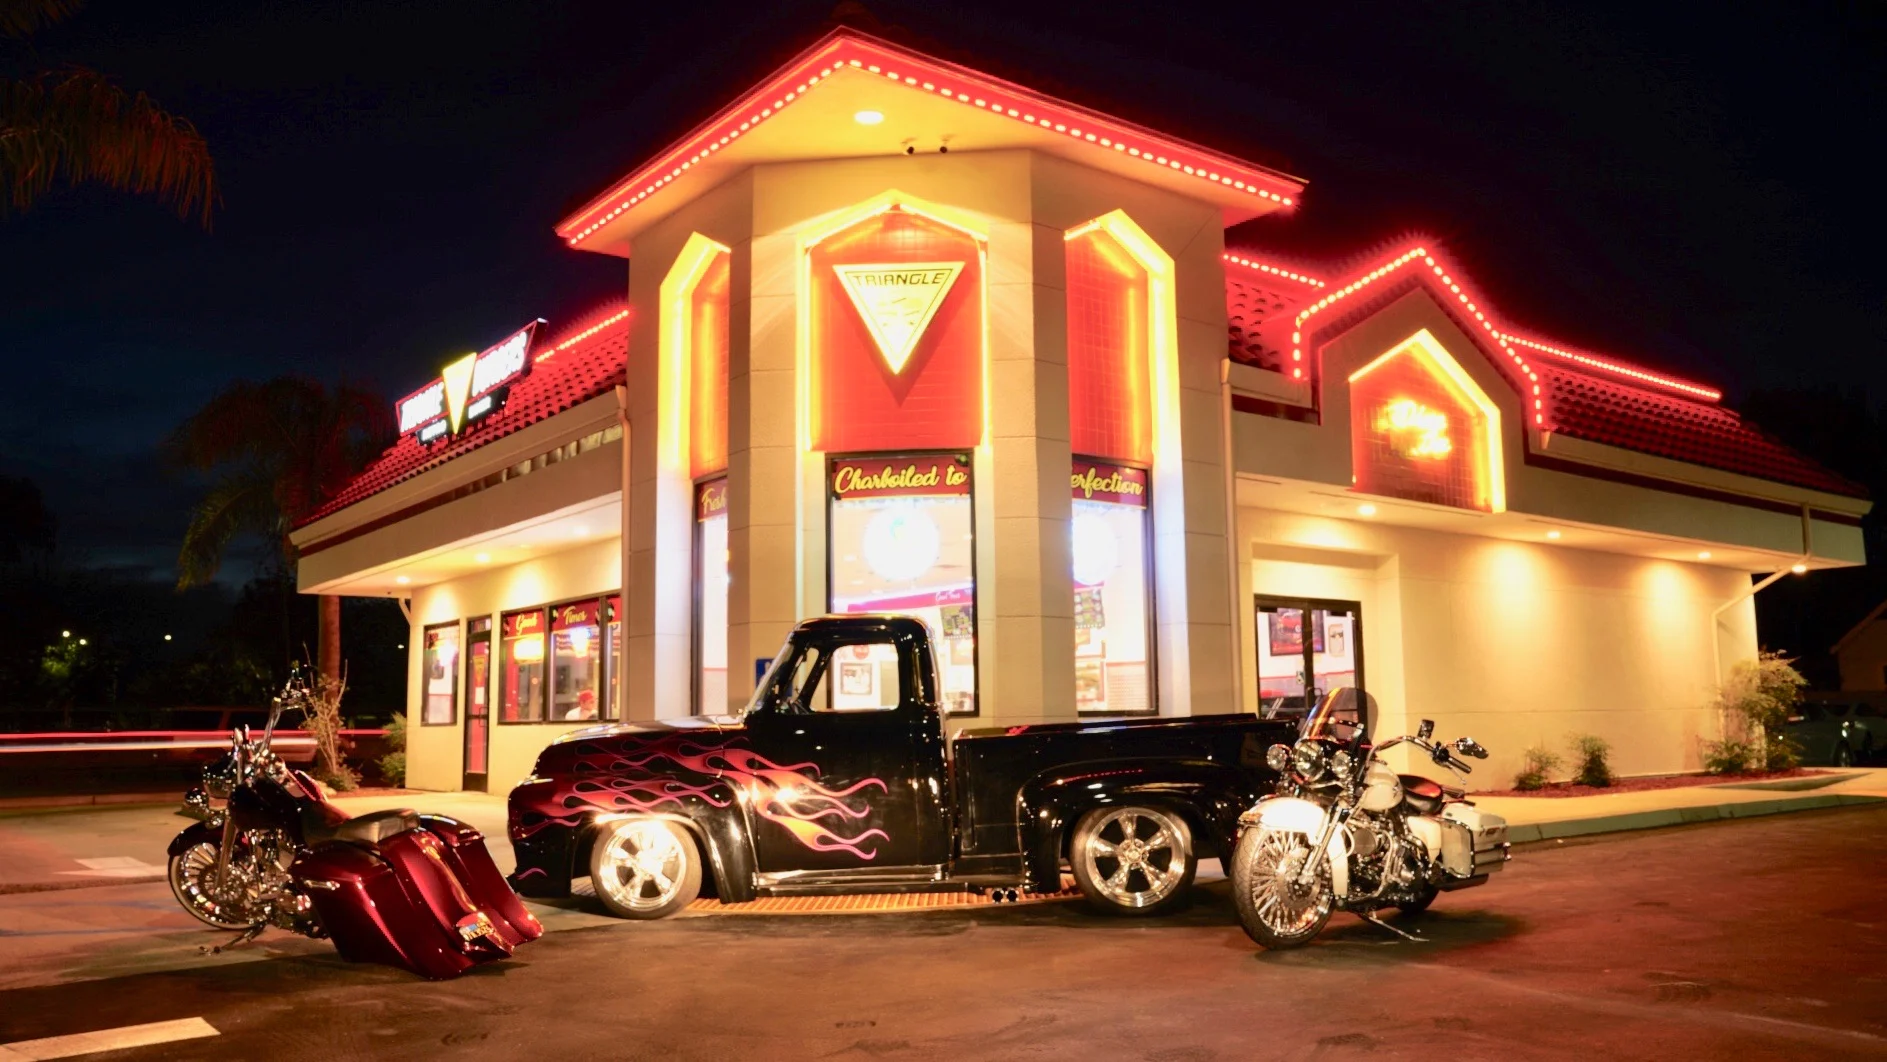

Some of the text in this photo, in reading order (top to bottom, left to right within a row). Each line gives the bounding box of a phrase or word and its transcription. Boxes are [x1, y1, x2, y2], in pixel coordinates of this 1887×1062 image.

[853, 272, 946, 286] TRIANGLE
[834, 464, 968, 493] Charboiled to
[1071, 467, 1144, 499] erfection
